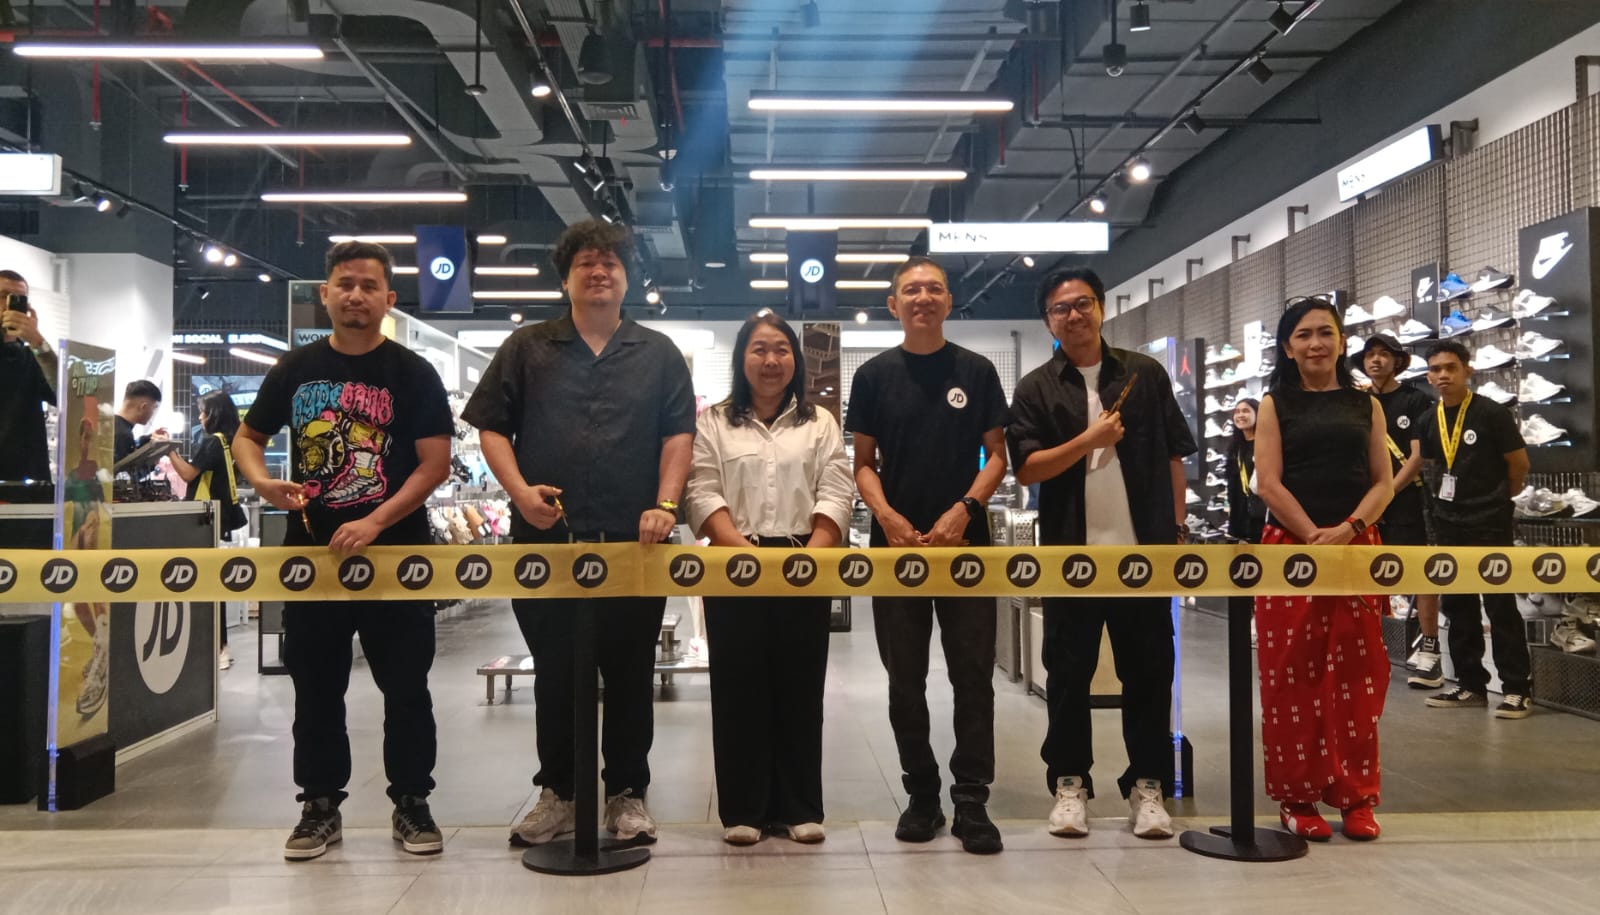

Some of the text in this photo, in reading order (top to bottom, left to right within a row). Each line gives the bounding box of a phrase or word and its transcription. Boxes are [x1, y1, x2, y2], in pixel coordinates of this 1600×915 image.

[434, 262, 452, 274] JD
[804, 265, 821, 277] JD
[184, 334, 224, 343] SOCIAL
[950, 393, 964, 403] JD
[0, 558, 1600, 585] D JD JD JD JD JD JD JD JD JD JD JD JD JD JD JD JD JD JD JD JD JD JD JD JD JD JD J
[142, 601, 184, 663] JD
